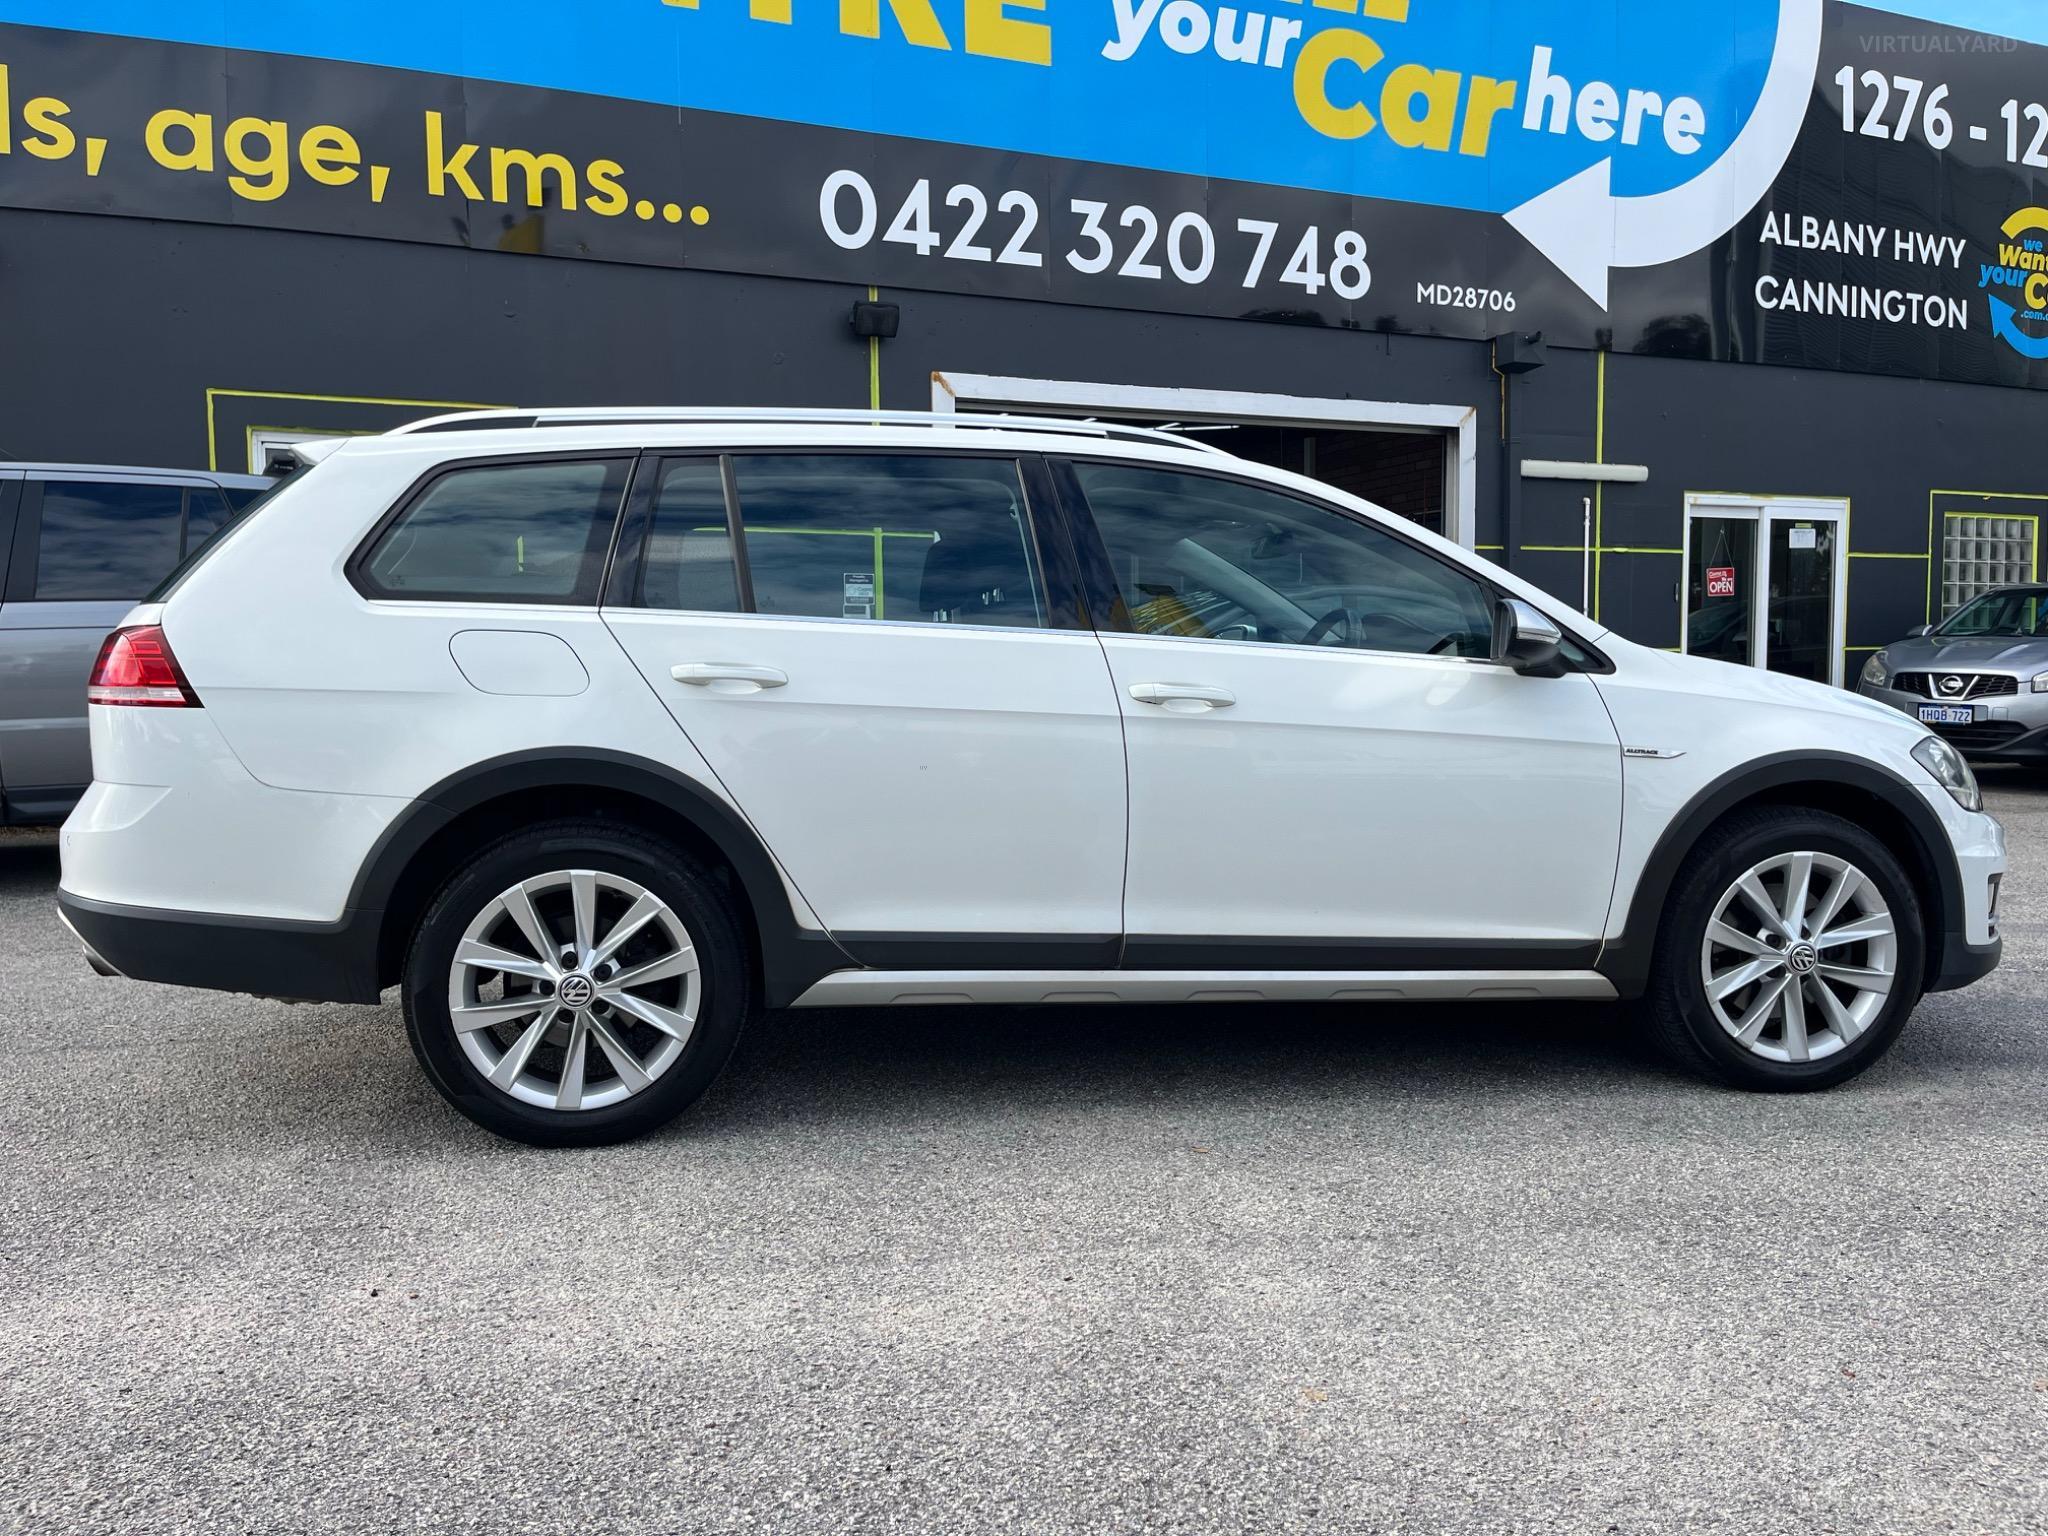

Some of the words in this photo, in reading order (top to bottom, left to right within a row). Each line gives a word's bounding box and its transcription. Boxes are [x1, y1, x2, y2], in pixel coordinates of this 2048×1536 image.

[1101, 0, 1303, 69] your
[1293, 27, 1518, 158] Car
[1522, 44, 1706, 155] here
[1835, 64, 1954, 151] 1276
[2000, 98, 2048, 169] 12
[144, 108, 391, 203] age,
[425, 110, 710, 226] kms...
[819, 169, 1043, 268] 0422
[1064, 198, 1216, 285] 320
[1237, 218, 1371, 301] 748
[1759, 210, 1887, 258] ALBANY
[1893, 229, 1967, 269] HWY
[2023, 239, 2043, 252] we
[1416, 281, 1517, 313] MD28706
[1754, 274, 1968, 331] CANNINGTON
[1977, 264, 2028, 289] your
[1709, 581, 1733, 593] OPEN
[1952, 709, 1971, 722] 722
